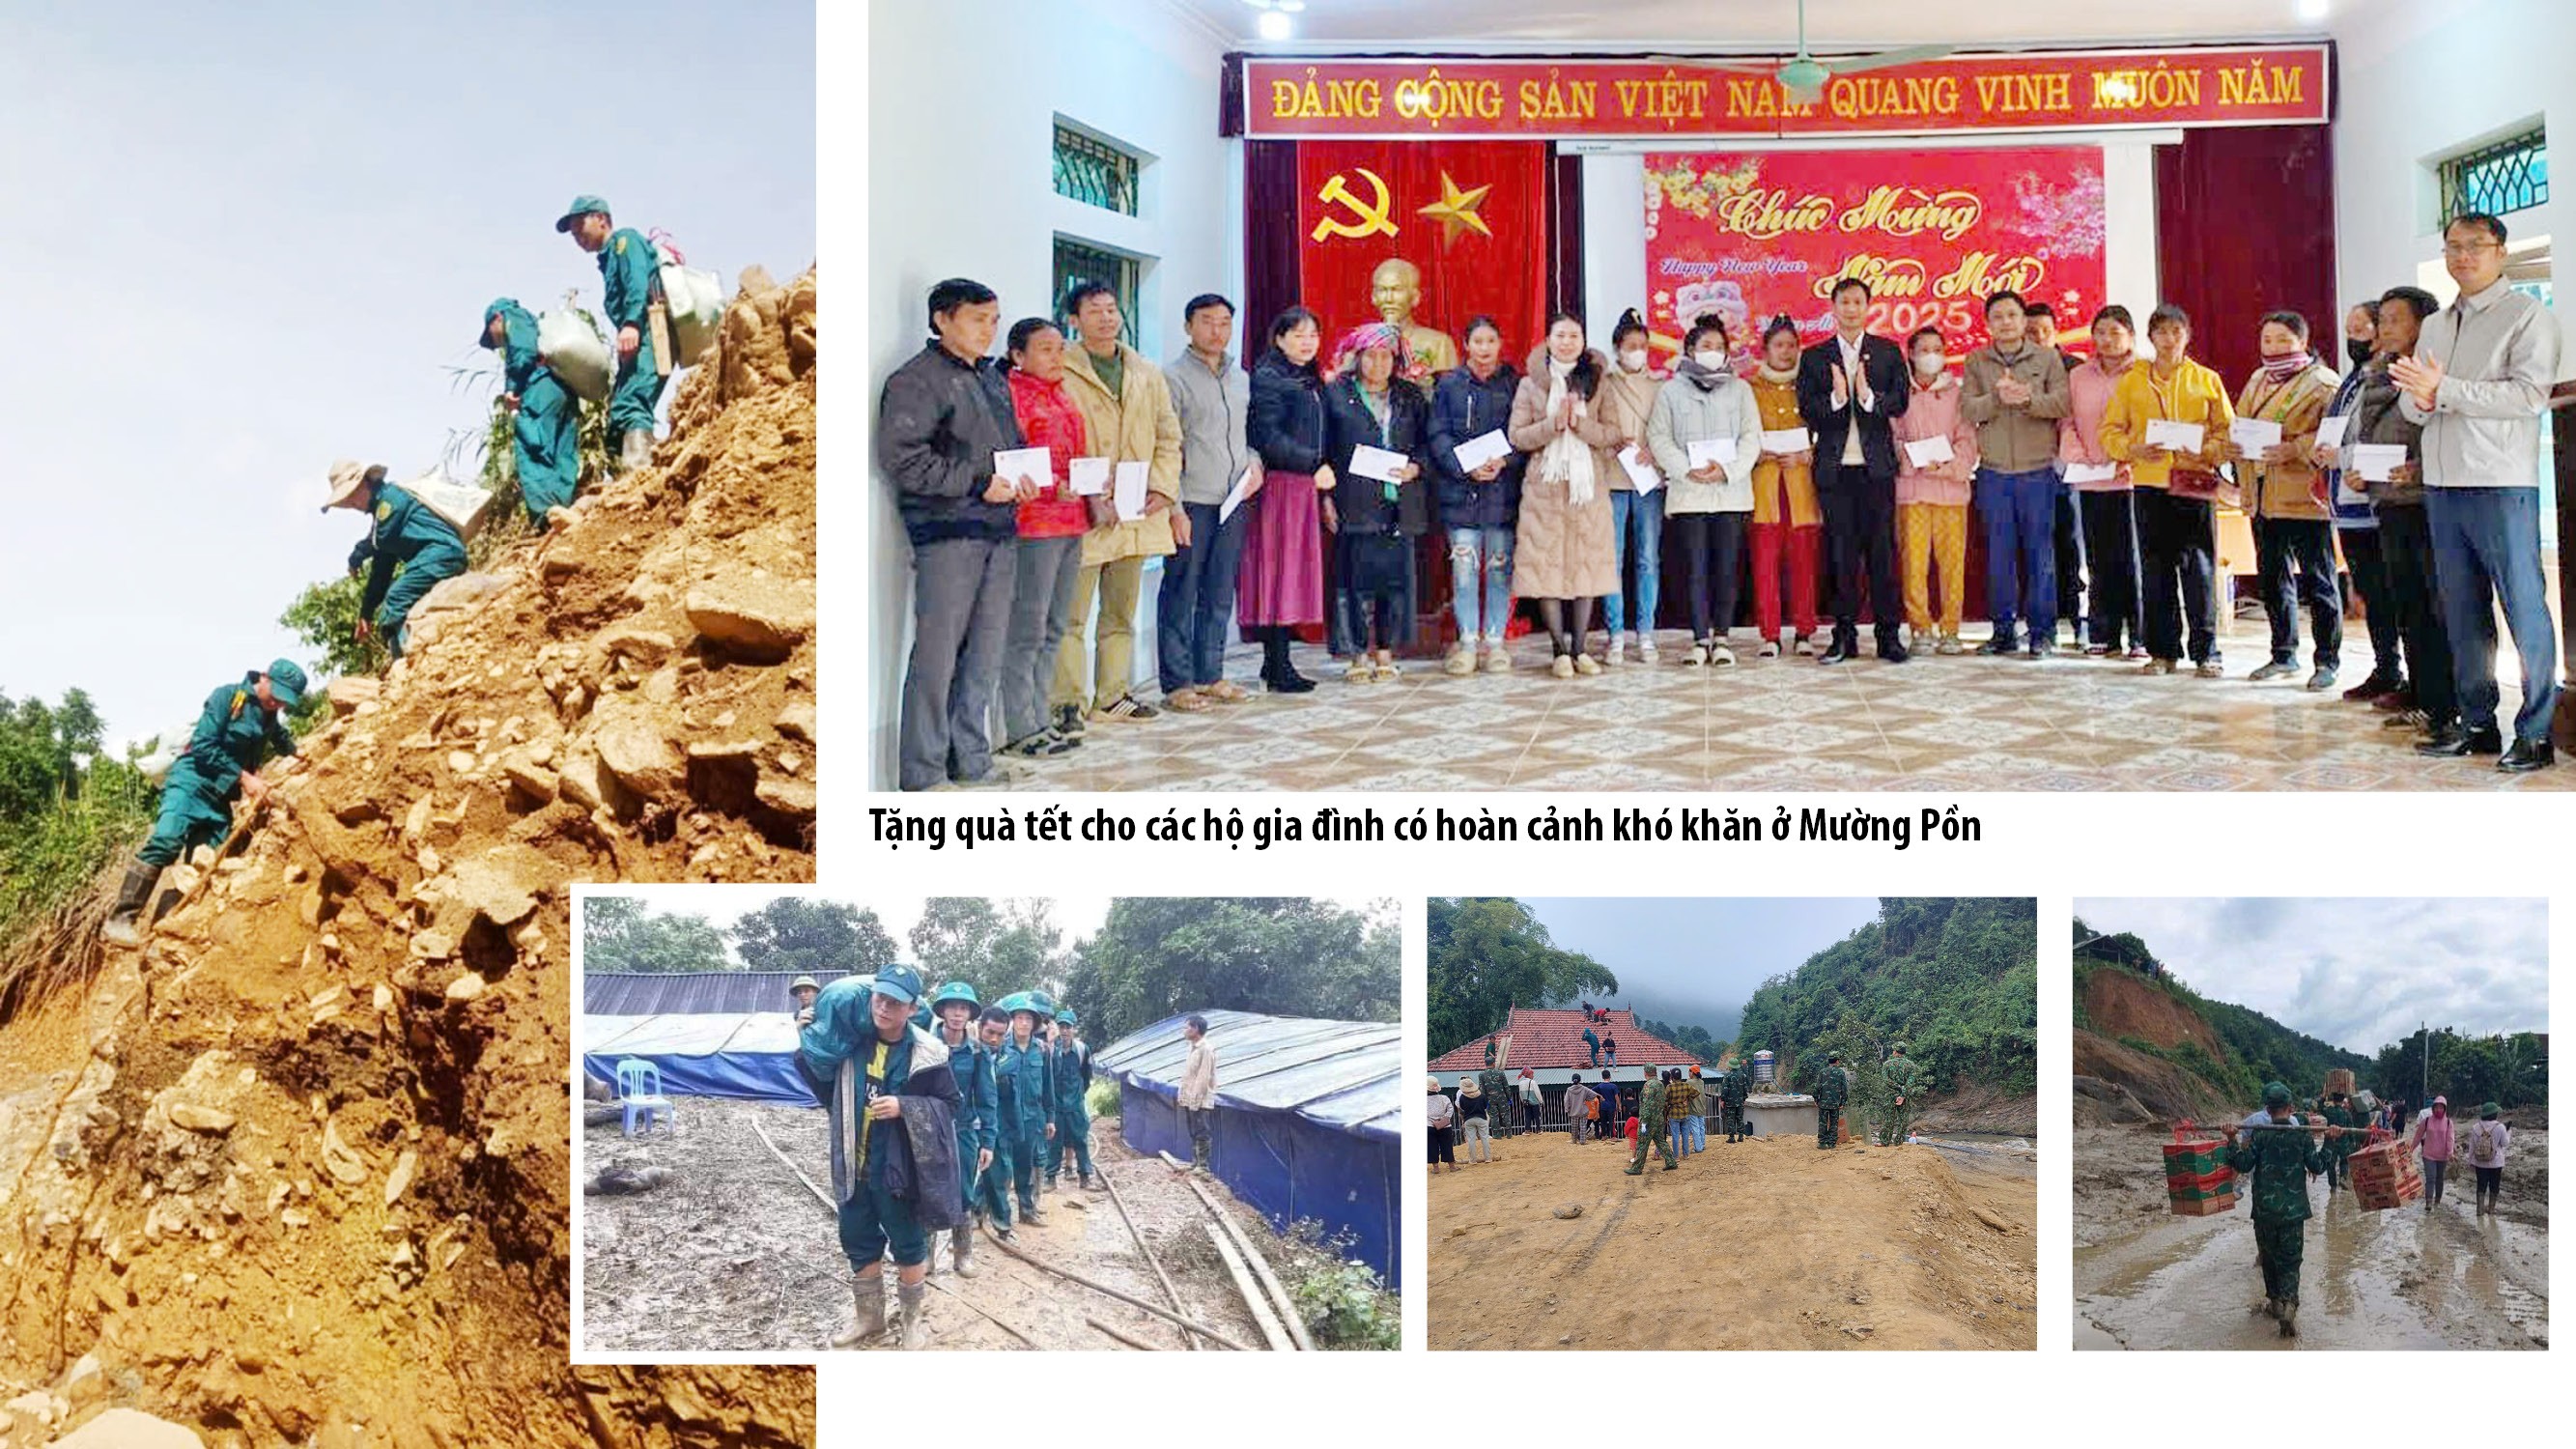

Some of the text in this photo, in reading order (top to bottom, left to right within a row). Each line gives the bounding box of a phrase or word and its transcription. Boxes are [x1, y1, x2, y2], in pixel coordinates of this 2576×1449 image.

[1272, 66, 1381, 118] ĐẢNG
[1394, 70, 1503, 128] CỘNG
[1519, 68, 1596, 118] SẢN
[1615, 69, 1708, 128] VIỆT
[1829, 77, 1960, 119] QUANG
[1974, 74, 2072, 113] VINH
[2091, 59, 2201, 111] MUÔN
[2218, 57, 2304, 105] NĂM
[1718, 185, 1982, 242] Chúc Mừng
[1660, 257, 1808, 276] Happy New Year
[1932, 251, 2045, 301] Mới
[1865, 301, 1972, 335] 2025
